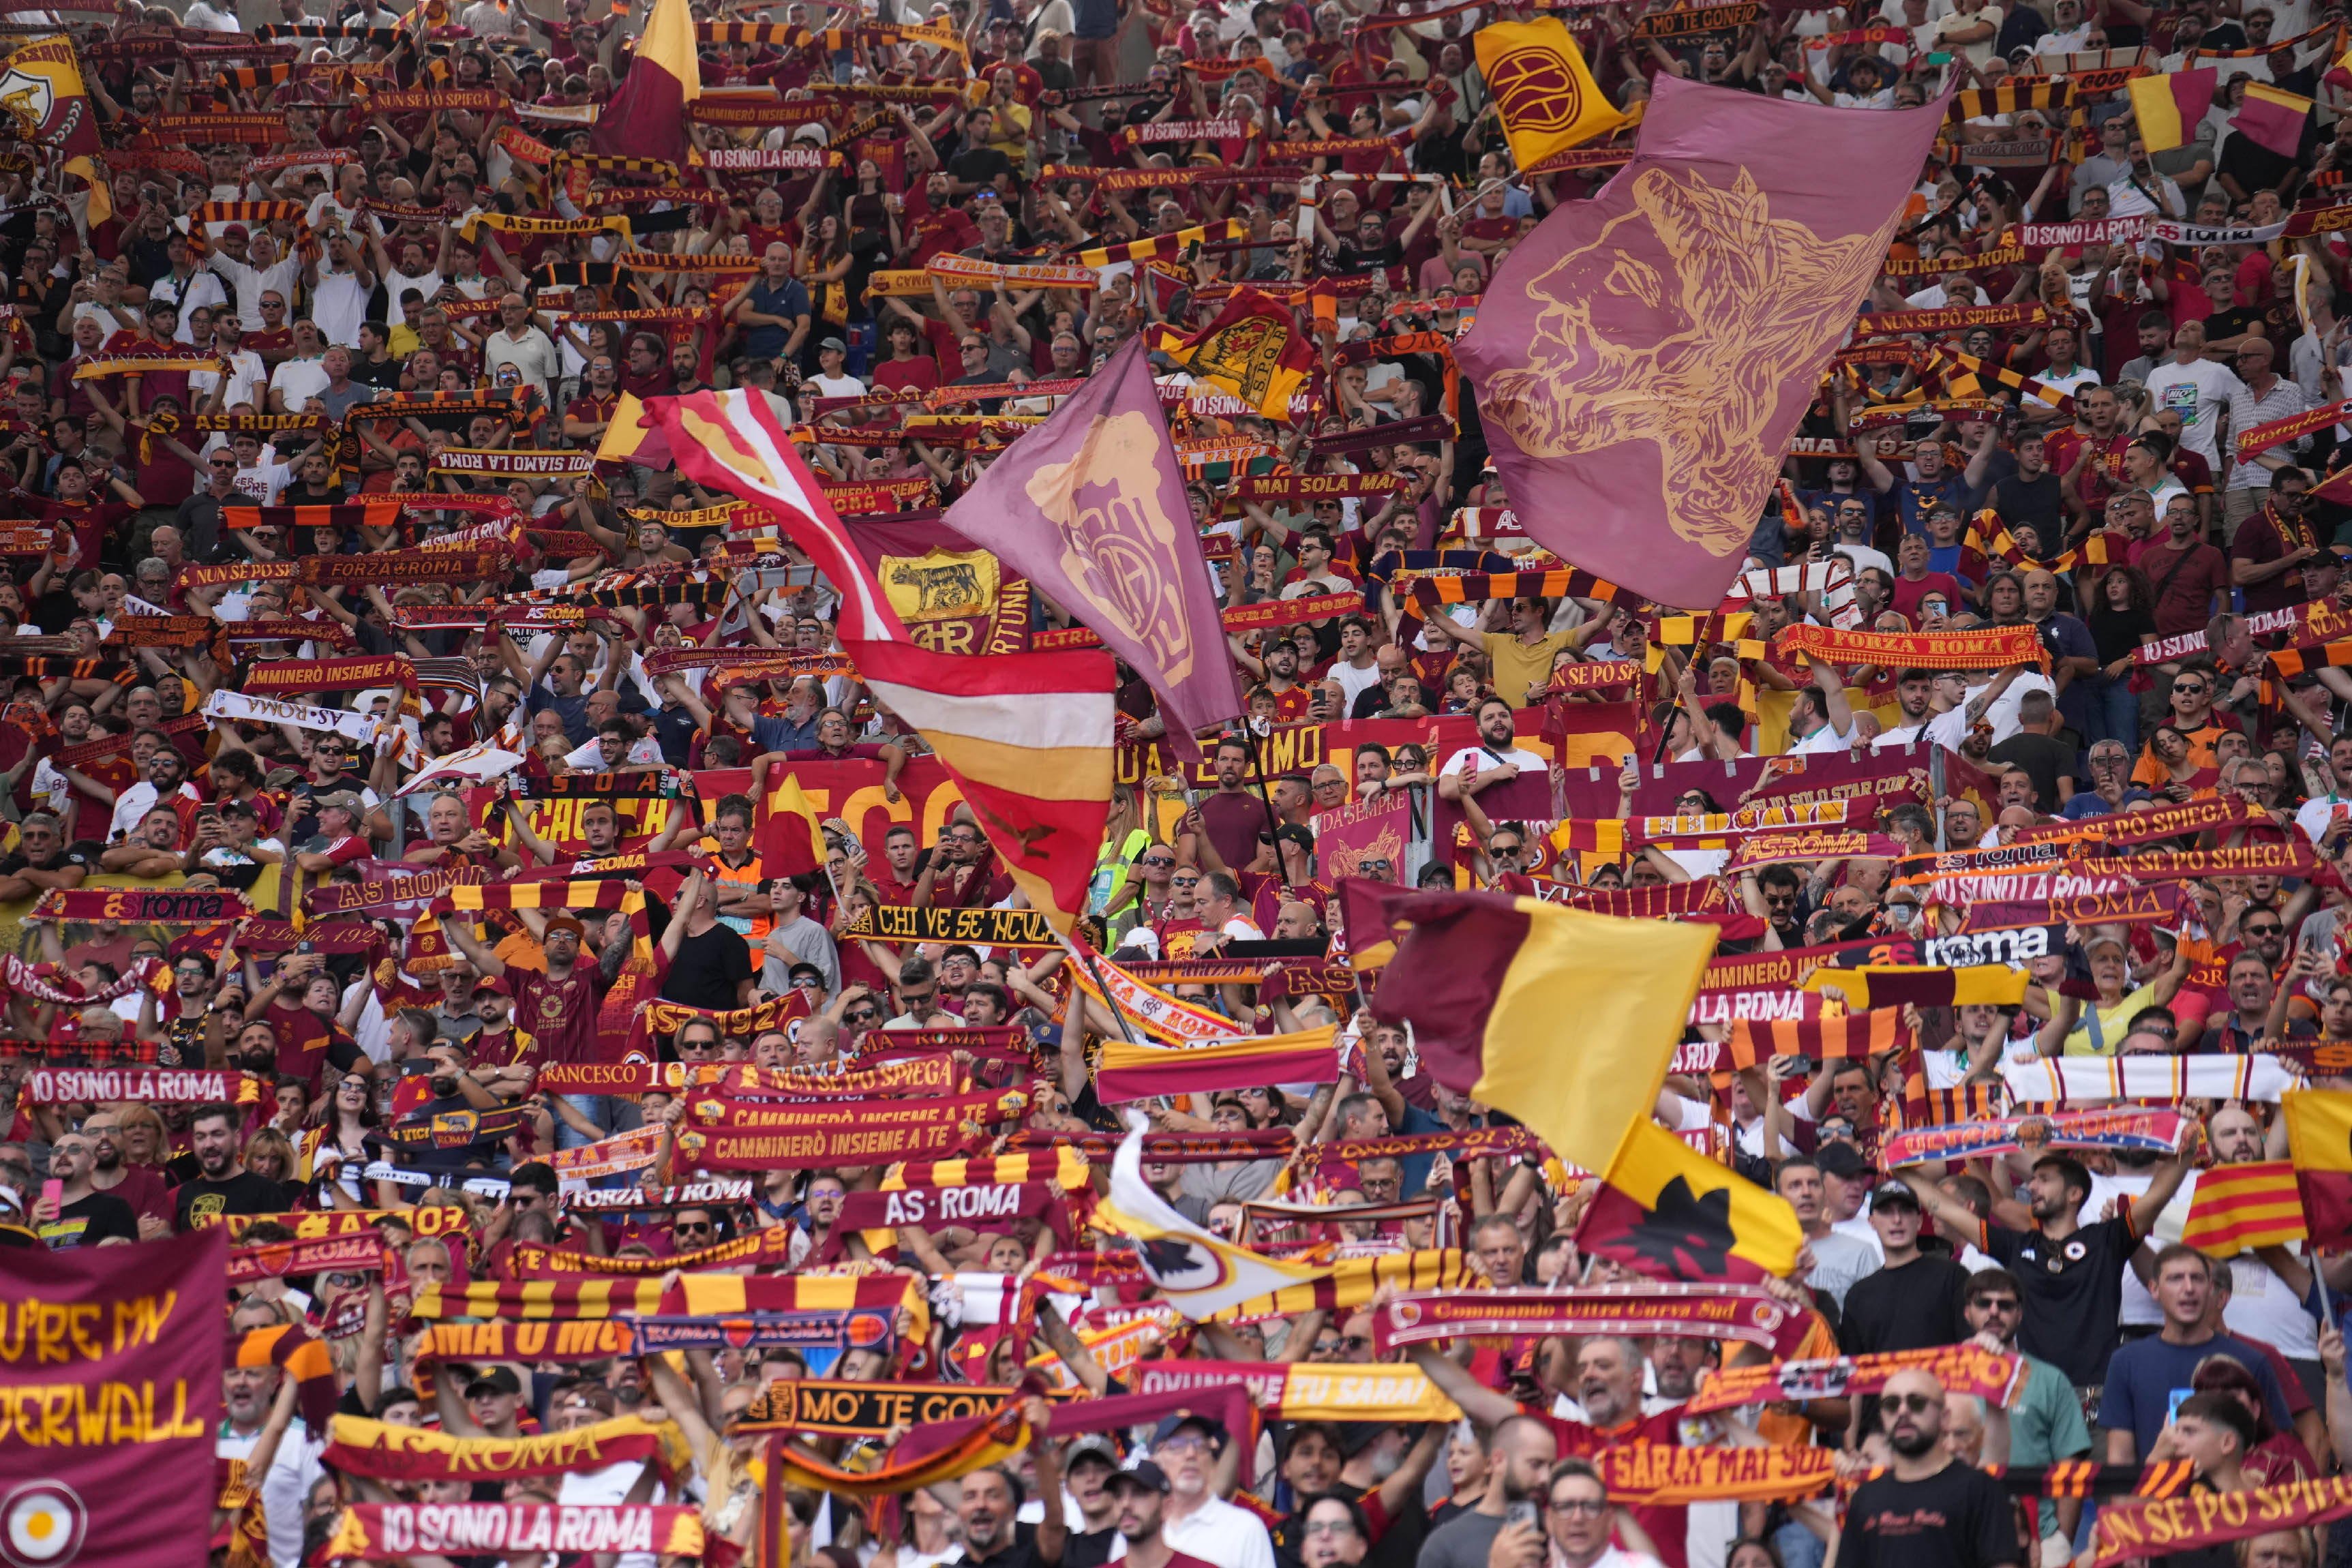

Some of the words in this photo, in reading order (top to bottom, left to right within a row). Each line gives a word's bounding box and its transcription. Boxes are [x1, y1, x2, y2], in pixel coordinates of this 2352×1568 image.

[1653, 18, 1677, 35] MO'
[1681, 14, 1699, 32] TE
[1702, 6, 1757, 29] GONFIO
[378, 92, 404, 107] NUN
[408, 92, 423, 107] SE
[160, 116, 186, 127] LUPI
[693, 105, 753, 122] CAMMINERÒ
[757, 106, 804, 121] INSIEME
[1154, 121, 1187, 139] SONO
[1187, 123, 1206, 140] LA
[1206, 119, 1241, 138] ROMA
[709, 150, 723, 168] IO
[724, 149, 760, 168] SONO
[762, 149, 779, 167] LA
[781, 149, 822, 167] ROMA
[1108, 172, 1141, 190] NUN
[1143, 170, 1160, 187] SE
[1163, 165, 1181, 185] PÒ
[504, 217, 532, 230] AS
[539, 218, 604, 232] ROMA
[2022, 226, 2036, 245] IO
[2040, 224, 2081, 245] SONO
[2084, 222, 2105, 242] LA
[952, 260, 994, 275] FORZA
[1017, 264, 1068, 279] ROMA
[1977, 246, 2025, 268] ROMA
[1881, 314, 1915, 331] NUN
[1916, 311, 1938, 328] SE
[1942, 307, 1963, 326] PÒ
[1965, 304, 2021, 325] SPIEGÀ
[195, 414, 230, 430] AS
[239, 414, 318, 430] ROMA
[439, 454, 487, 469] ROMA
[490, 456, 513, 470] LA
[517, 457, 567, 471] SIAMO
[1253, 478, 1290, 494] MAI
[1302, 477, 1348, 493] SOLA
[196, 569, 228, 585] NUN
[230, 567, 248, 581] SE
[331, 562, 390, 577] FORZA
[408, 560, 463, 575] ROMA
[526, 607, 545, 619] AS
[545, 607, 584, 619] ROMA
[2307, 613, 2347, 639] NUN
[516, 635, 532, 644] NOT
[1833, 631, 1916, 653] FORZA
[1929, 636, 2004, 655] ROMA
[669, 649, 715, 662] Commando
[2143, 643, 2162, 662] IO
[326, 662, 380, 681] INSIEME
[383, 661, 395, 675] A
[398, 660, 415, 679] TE
[741, 653, 838, 678] ROMA
[1568, 666, 1589, 685] SE
[1591, 661, 1615, 684] PÒ
[1830, 784, 1873, 806] STAR
[1875, 777, 1909, 795] CON
[1324, 808, 1346, 834] DA
[2115, 810, 2147, 839] PÒ
[2152, 796, 2235, 834] SPIEGÀ
[571, 858, 595, 874] AS
[594, 854, 646, 871] ROMA
[1935, 852, 1967, 869] as
[1974, 842, 2057, 865] roma
[2083, 857, 2131, 877] NUN
[2138, 854, 2165, 872] SE
[104, 892, 140, 919] as
[141, 893, 224, 920] roma
[340, 881, 384, 909] AS
[2047, 886, 2164, 922] ROMA
[879, 905, 918, 938] CHI
[924, 907, 952, 937] VE
[956, 911, 986, 939] SE
[267, 924, 325, 949] Luglio
[1925, 926, 2049, 966] roma
[1284, 966, 1357, 993] AS
[719, 998, 792, 1035] 1927
[1700, 994, 1730, 1024] LA
[1733, 990, 1805, 1023] ROMA
[815, 1072, 843, 1093] SE
[880, 1055, 953, 1087] SPIEGÀ
[31, 1074, 56, 1102] IO
[56, 1074, 123, 1102] SONO
[124, 1074, 155, 1101] LA
[157, 1074, 226, 1102] ROMA
[943, 1109, 958, 1124] A
[963, 1104, 987, 1124] TE
[437, 1135, 469, 1145] ROMA
[715, 1130, 826, 1160] CAMMINERÒ
[830, 1128, 904, 1154] INSIEME
[907, 1130, 920, 1151] A
[924, 1125, 948, 1147] TE
[571, 1190, 645, 1207] FORZA
[682, 1180, 753, 1203] ROMA
[885, 1190, 926, 1225] AS
[940, 1183, 1021, 1219] ROMA
[1432, 1301, 1555, 1320] Commando
[1566, 1299, 1625, 1320] Ultra
[1627, 1299, 1690, 1320] Curva
[1696, 1299, 1739, 1321] Sud
[1290, 1377, 1333, 1404] TU
[1334, 1377, 1428, 1405] SARAI
[802, 1391, 865, 1424] MO'
[877, 1393, 916, 1425] TE
[449, 1429, 603, 1474] ROMA
[1614, 1447, 1704, 1488] SARAI
[1717, 1446, 1770, 1483] MAI
[382, 1506, 413, 1552] IO
[418, 1506, 507, 1552] SONO
[509, 1506, 552, 1552] LA
[555, 1506, 652, 1552] ROMA
[2143, 1498, 2193, 1541] SE
